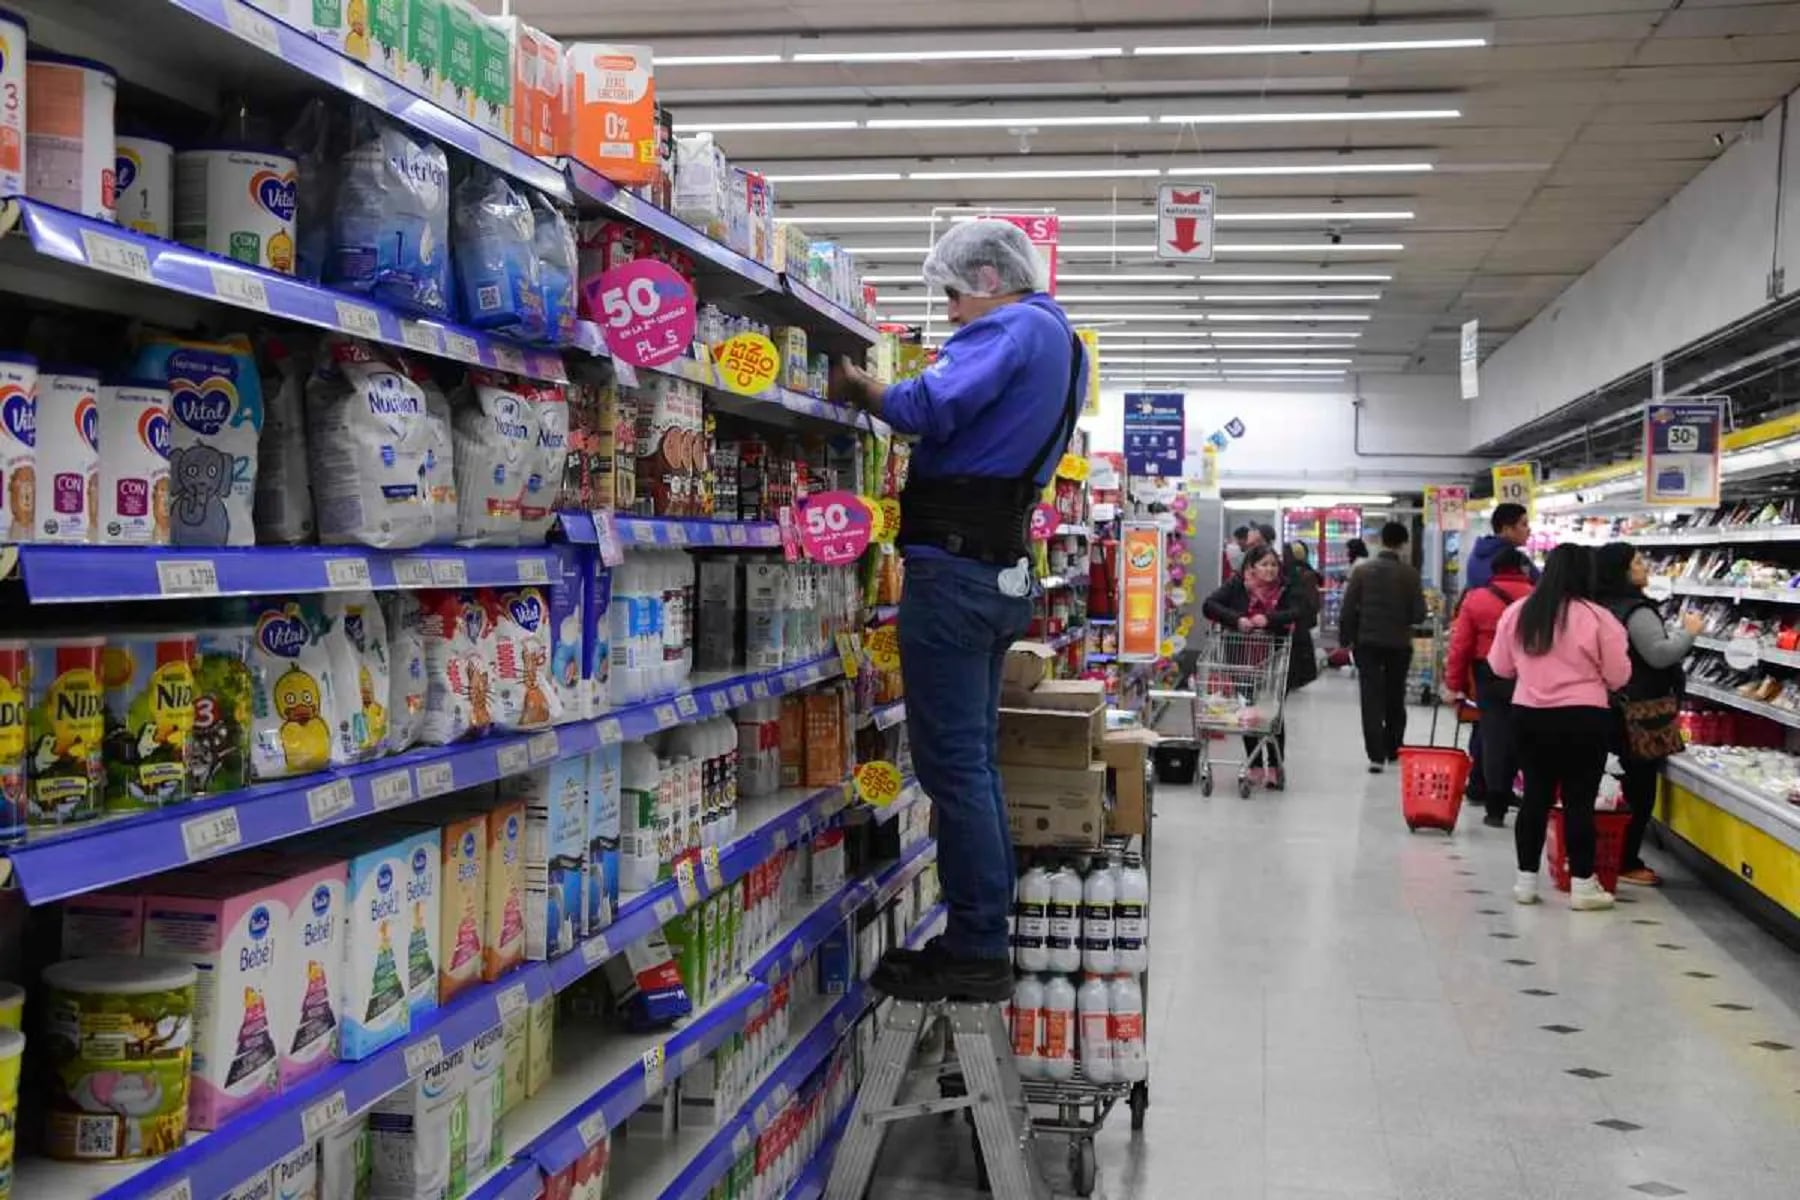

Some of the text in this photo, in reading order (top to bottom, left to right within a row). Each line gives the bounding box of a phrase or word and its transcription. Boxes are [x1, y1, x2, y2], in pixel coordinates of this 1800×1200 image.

[5, 83, 18, 110] 3
[602, 278, 661, 327] 50
[182, 400, 226, 421] Vital
[234, 455, 251, 482] 2
[58, 475, 81, 492] CON
[121, 480, 146, 496] CON
[806, 504, 849, 534] 50
[195, 699, 214, 727] 3
